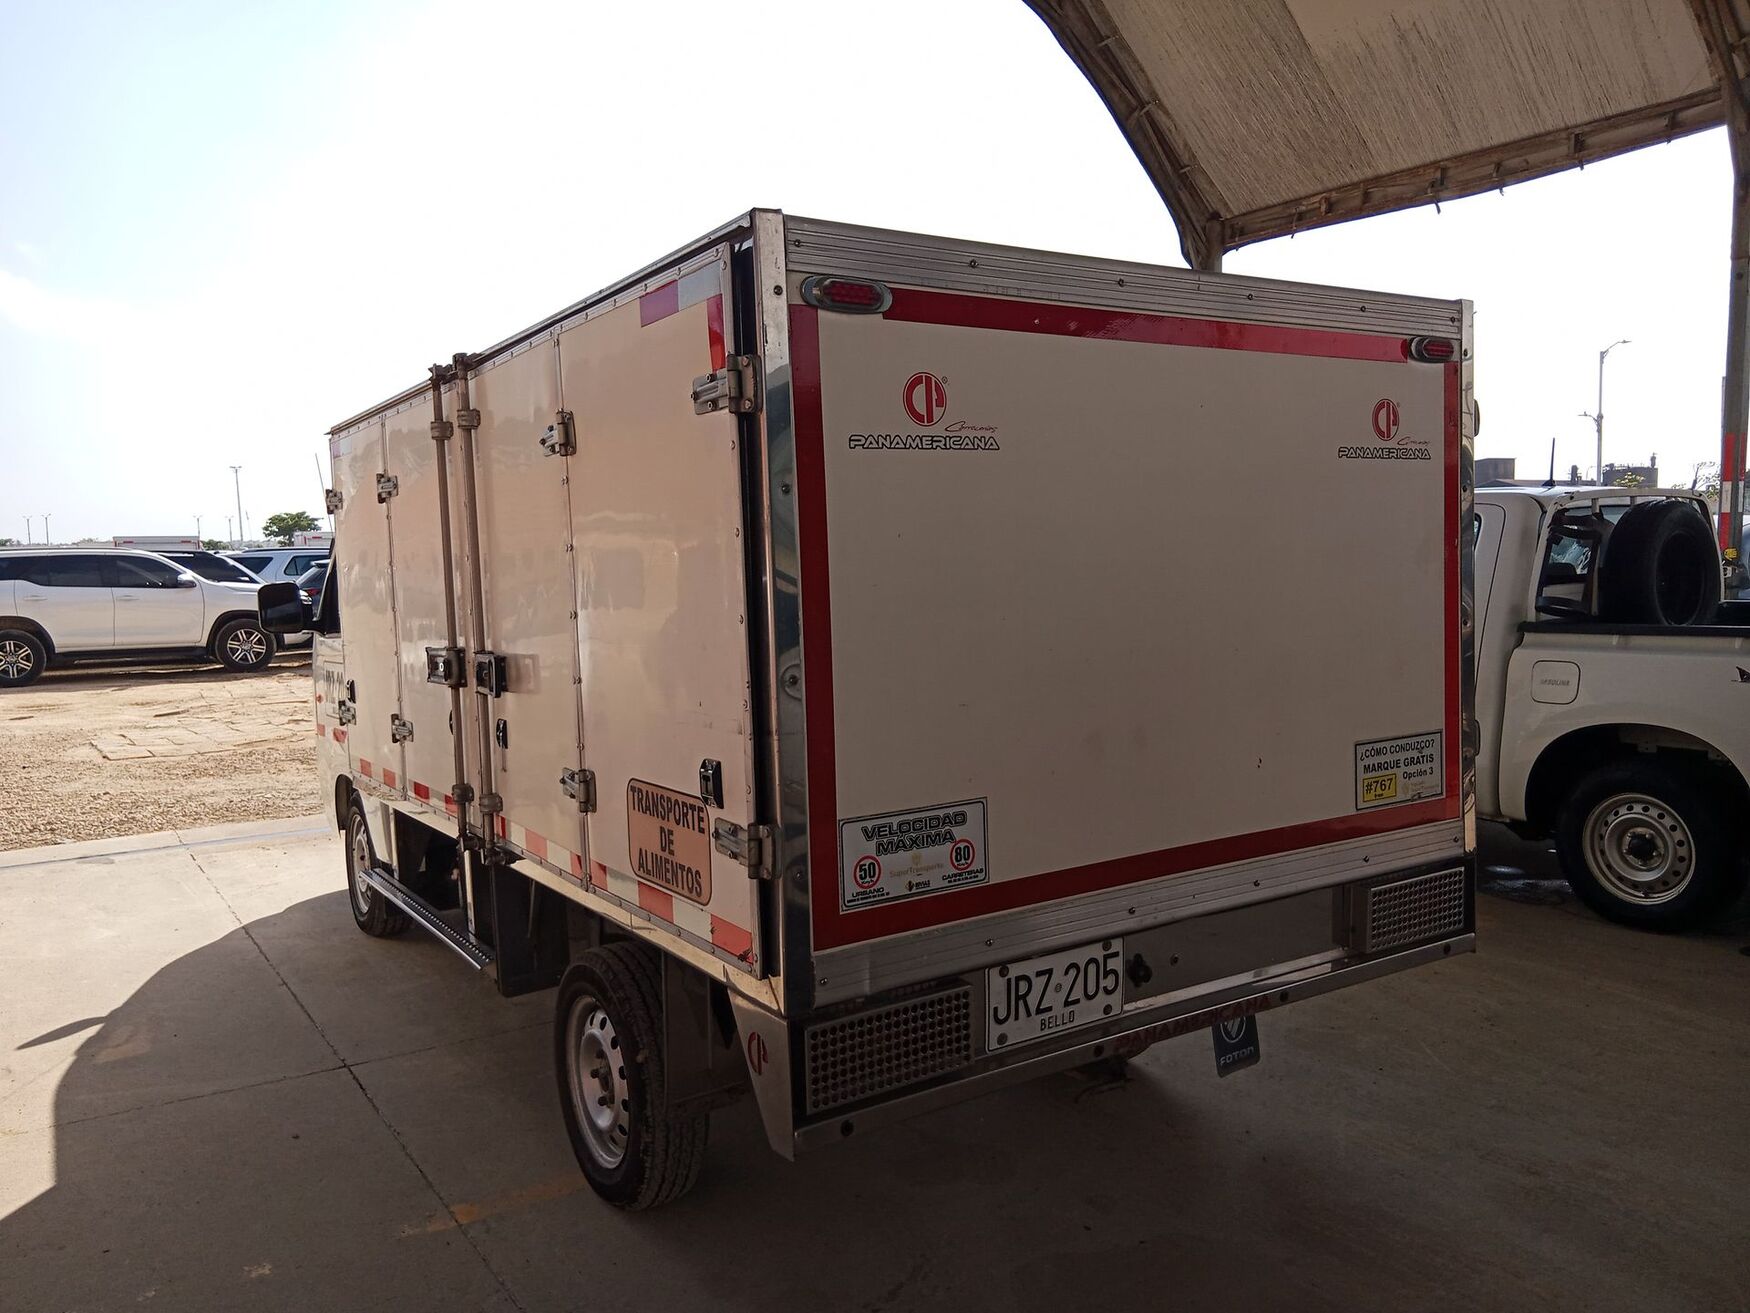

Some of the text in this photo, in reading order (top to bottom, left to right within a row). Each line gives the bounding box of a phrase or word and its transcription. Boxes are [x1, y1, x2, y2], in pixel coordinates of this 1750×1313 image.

[849, 434, 1000, 450] PANAMERICANA
[1338, 446, 1431, 460] PANAMERICANA
[1360, 739, 1435, 761] ¿CÓMO CONDUZCO?
[1363, 754, 1434, 774] MARQUE GRATIS
[1402, 767, 1434, 780] Opción 3
[1365, 778, 1393, 794] #767
[630, 785, 705, 834] TRANSPORTE
[861, 811, 967, 841] VELOCIDAD
[659, 826, 675, 856] DE
[875, 829, 957, 856] MÁXIMA
[954, 845, 970, 863] 80
[638, 848, 703, 898] ALIMENTOS
[858, 862, 876, 881] 50
[852, 887, 884, 898] URBANO
[993, 951, 1120, 1025] JRZ 205
[1040, 1010, 1075, 1031] BELLO
[1220, 1046, 1254, 1066] FOTON
